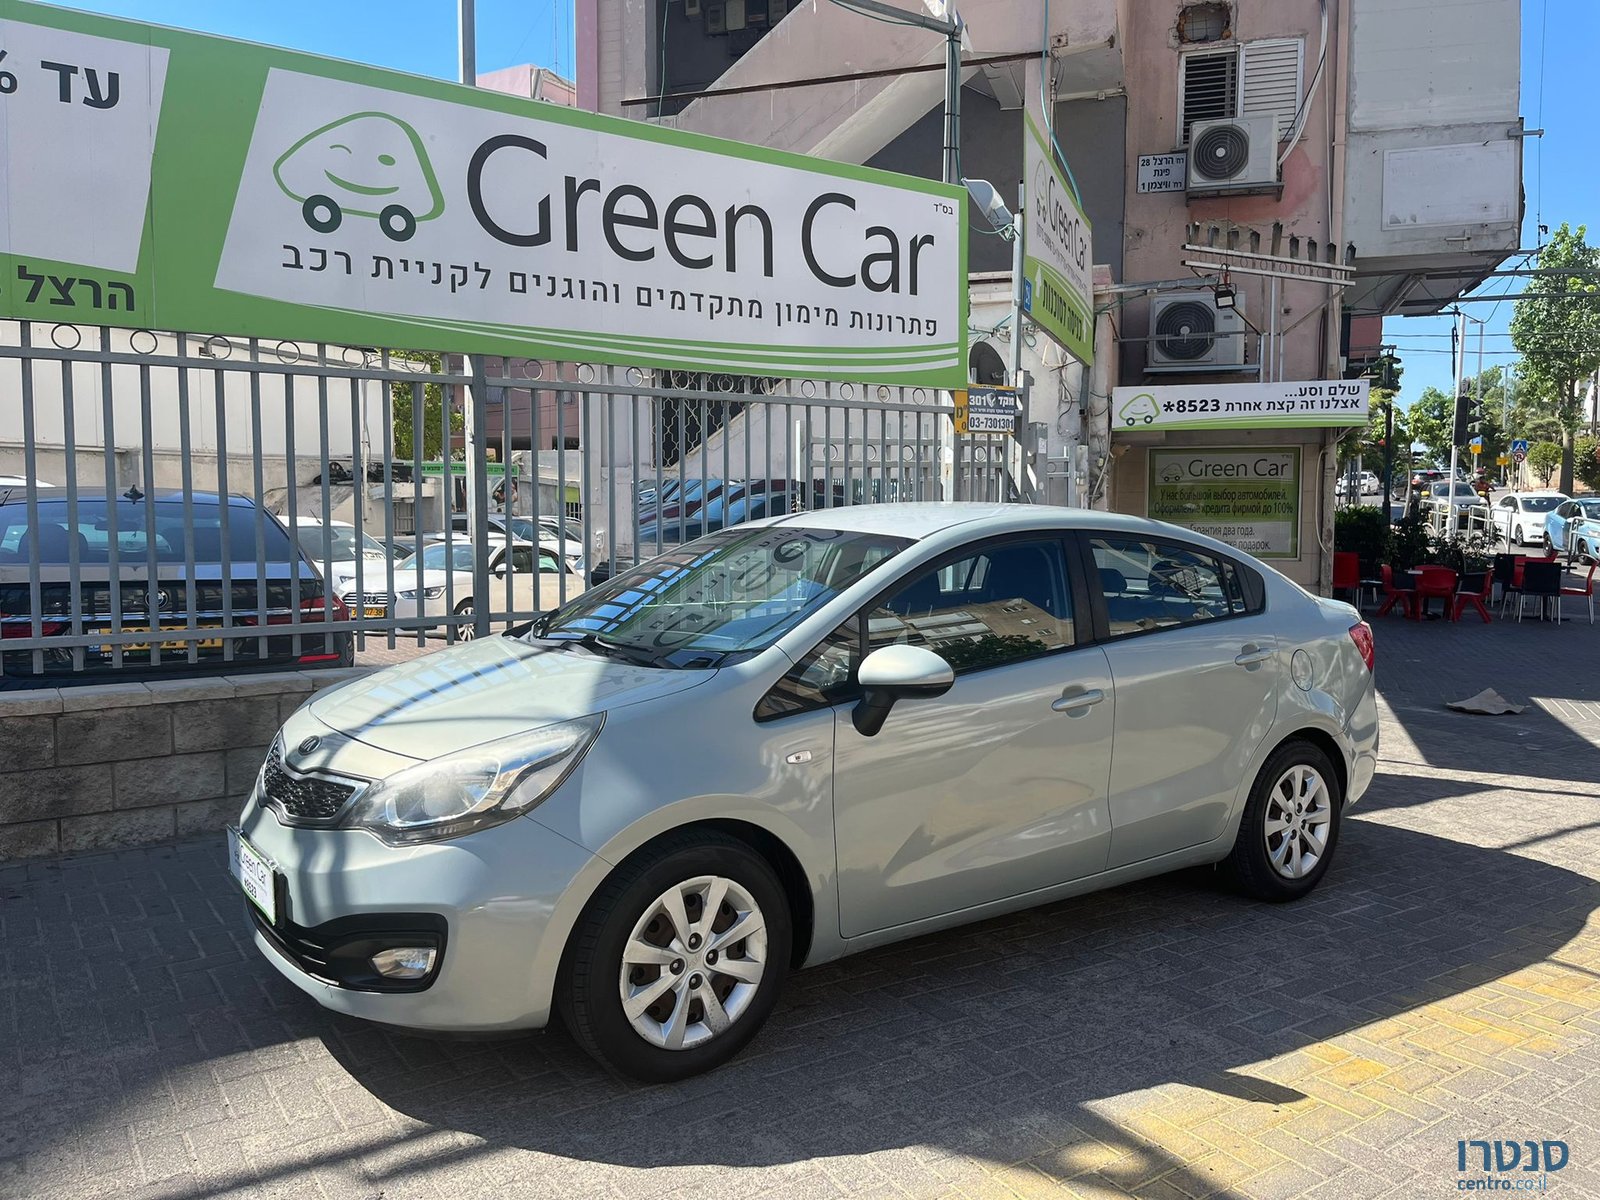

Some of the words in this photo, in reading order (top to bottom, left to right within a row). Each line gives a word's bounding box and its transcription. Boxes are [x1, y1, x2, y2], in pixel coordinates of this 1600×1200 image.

[41, 60, 120, 110] עד
[1140, 158, 1151, 167] 28
[1152, 156, 1174, 166] הרצל
[1153, 168, 1171, 178] פינת
[1141, 182, 1146, 191] 1
[1147, 180, 1171, 192] וויצמן
[466, 134, 774, 278] Green
[801, 192, 935, 297] Car
[933, 203, 955, 215] בס"ד
[1048, 175, 1074, 255] Green
[1074, 218, 1087, 272] Car
[282, 244, 352, 276] רכב
[371, 255, 491, 295] לקניית
[17, 264, 135, 313] הרצל
[509, 271, 621, 305] והוגנים
[636, 286, 763, 321] מתקדמים
[775, 302, 838, 328] מימון
[849, 310, 937, 337] פתרונות
[1285, 386, 1323, 398] וסע...
[1327, 384, 1361, 397] שלם
[969, 395, 987, 406] 301
[1224, 401, 1263, 412] אחרת
[1265, 400, 1296, 414] קצת
[1300, 400, 1316, 410] זה
[1319, 396, 1361, 410] אצלנו
[969, 416, 1014, 430] 03-7301301
[1188, 459, 1248, 477] Green
[1253, 458, 1289, 477] Car
[1160, 489, 1167, 501] У
[1166, 491, 1179, 501] нас
[1179, 488, 1212, 501] большой
[1213, 488, 1237, 502] выбор
[1237, 488, 1288, 501] автомобилей.
[1153, 502, 1201, 517] Оформление
[1202, 504, 1231, 516] кредита
[1231, 502, 1262, 517] фирмой
[1262, 505, 1273, 516] до
[1274, 502, 1294, 514] 100%
[1223, 526, 1236, 537] два
